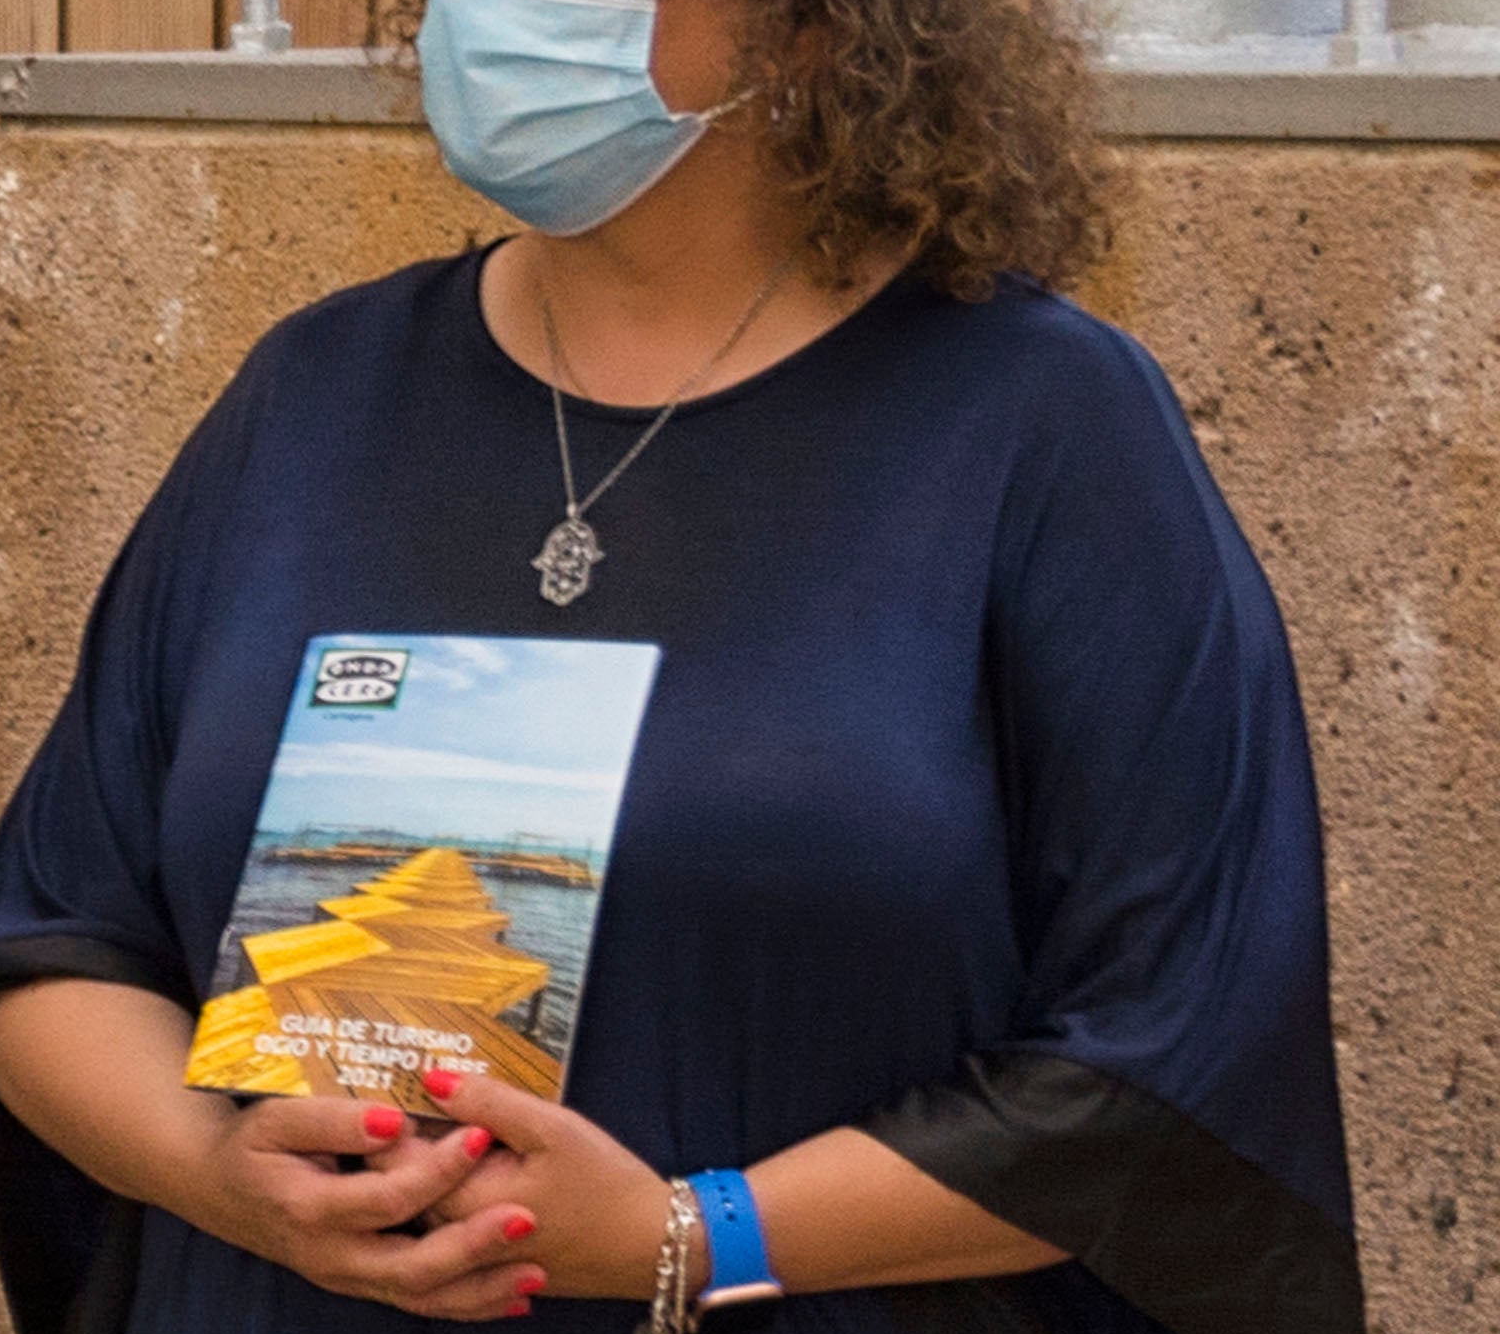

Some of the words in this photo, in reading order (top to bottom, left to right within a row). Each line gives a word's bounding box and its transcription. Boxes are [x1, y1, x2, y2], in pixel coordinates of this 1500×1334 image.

[339, 1019, 367, 1039] DE
[374, 1022, 474, 1055] TURISMO
[315, 1039, 332, 1059] Y
[336, 1041, 420, 1070] TIEMPO
